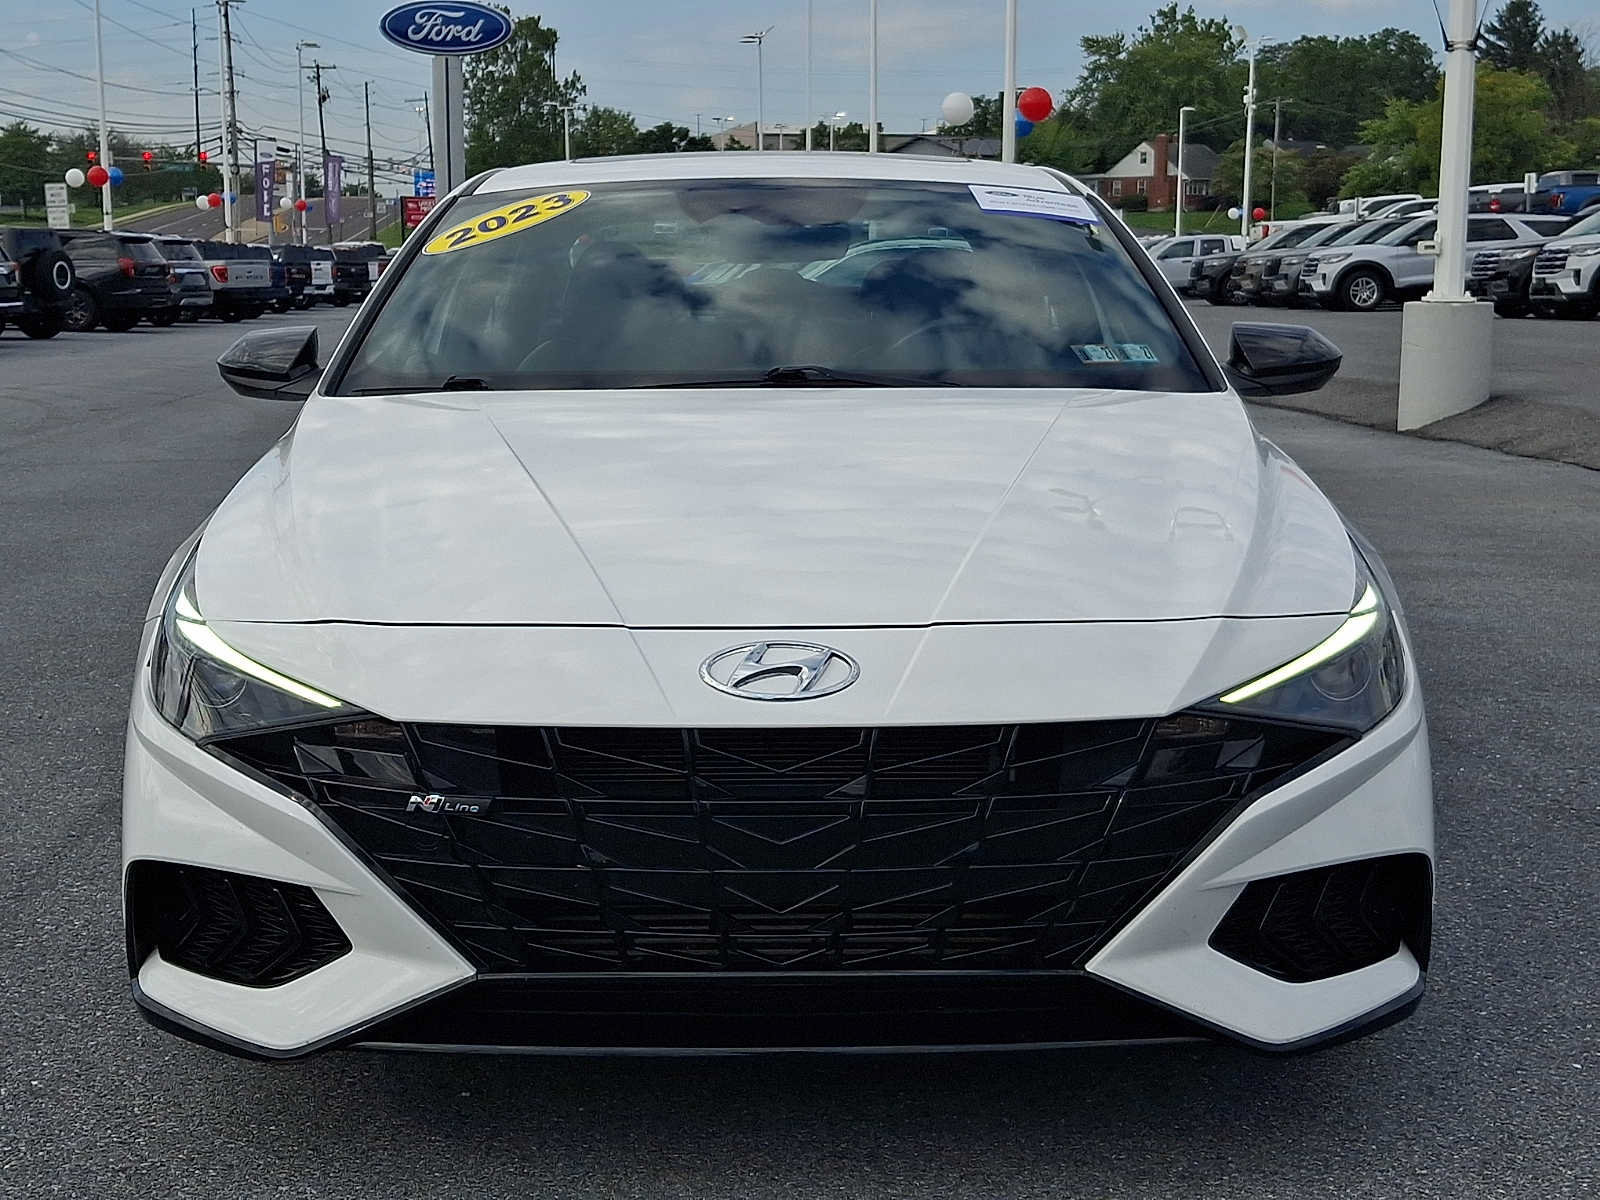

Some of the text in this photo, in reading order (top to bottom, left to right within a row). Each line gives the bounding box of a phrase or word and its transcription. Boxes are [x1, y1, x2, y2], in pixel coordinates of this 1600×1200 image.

[407, 9, 485, 43] Ford
[444, 193, 574, 248] 2023
[406, 794, 480, 813] N Line
